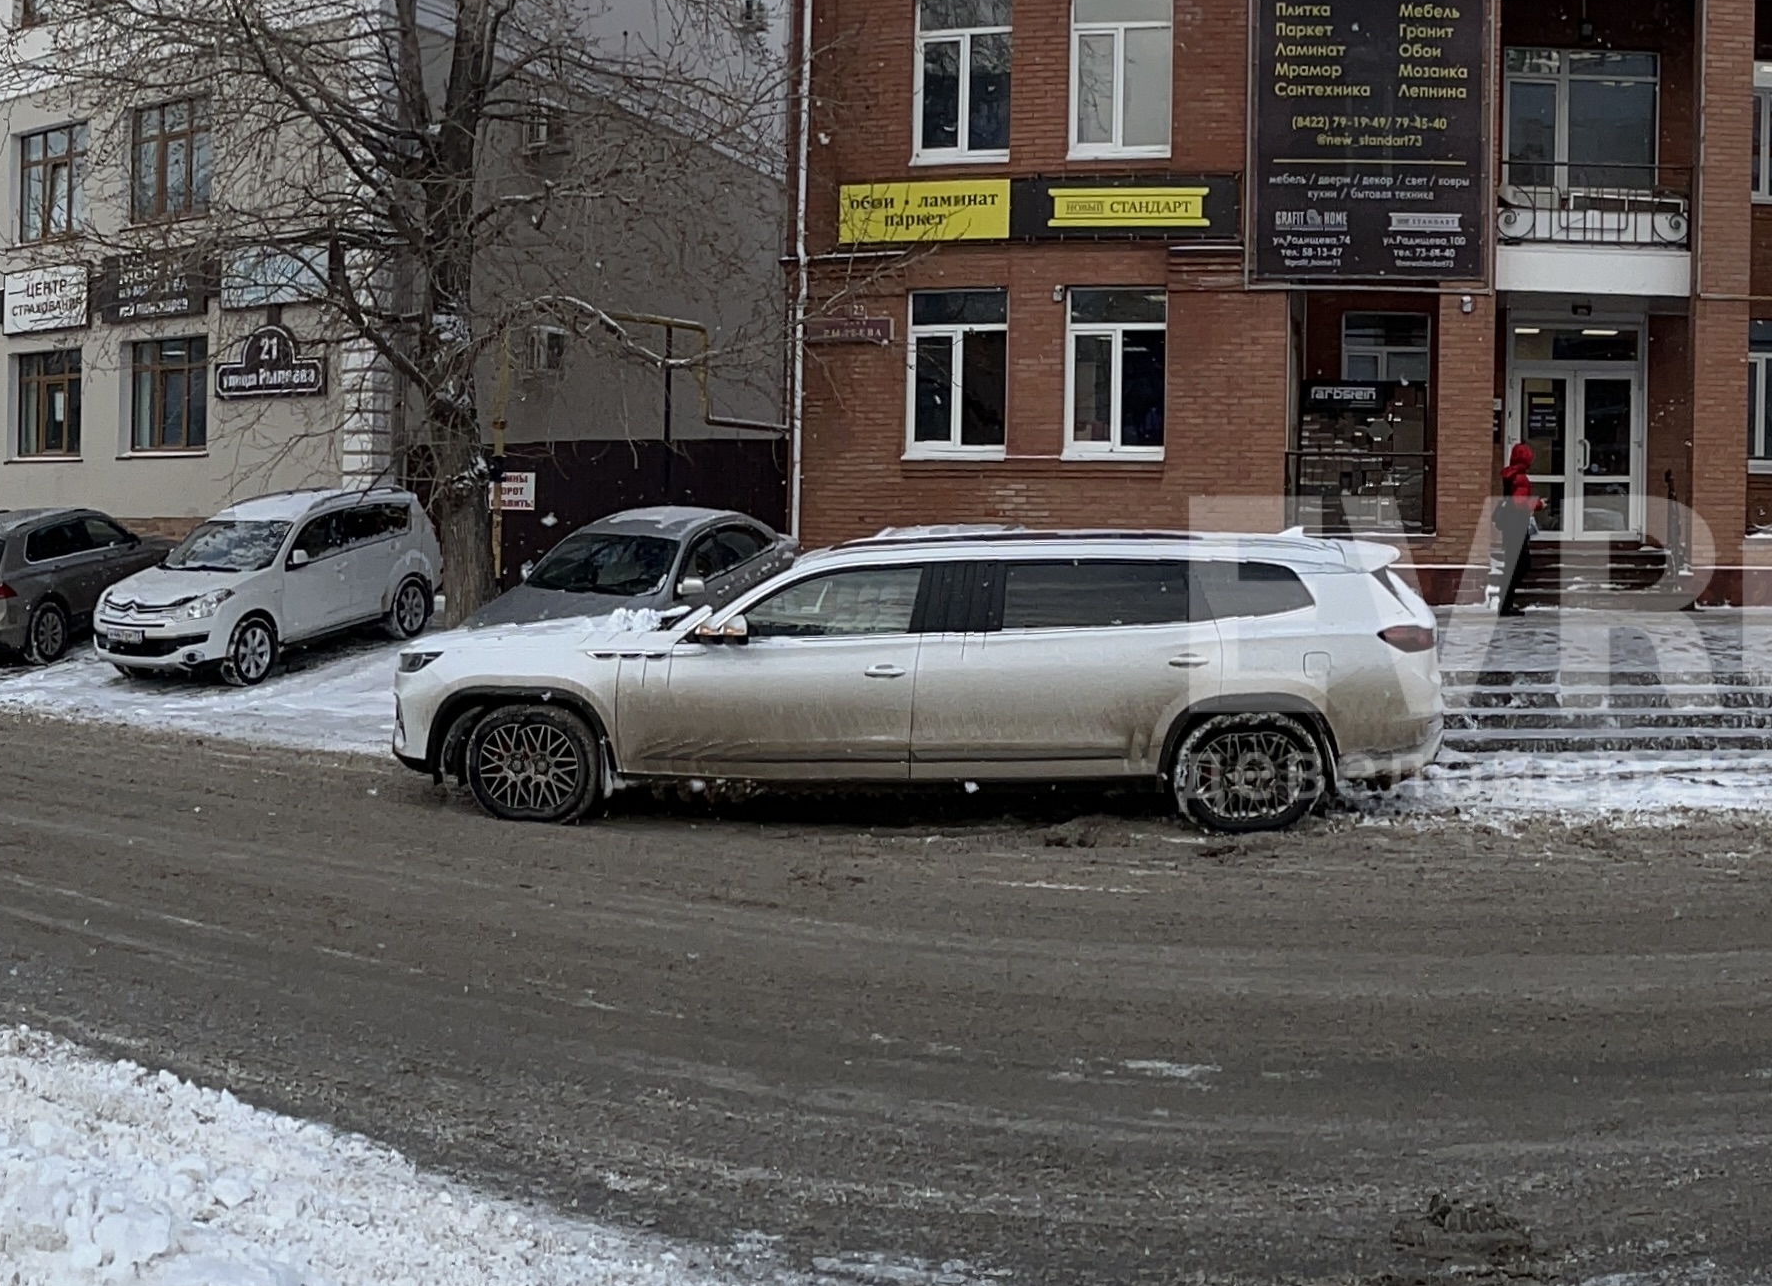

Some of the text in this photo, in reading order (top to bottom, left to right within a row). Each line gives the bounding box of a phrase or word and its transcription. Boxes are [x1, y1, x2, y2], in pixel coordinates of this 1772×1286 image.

[1275, 3, 1331, 17] Плитка
[1399, 4, 1460, 18] Мебель
[1275, 23, 1333, 38] Паркет
[1399, 24, 1454, 39] Гранит
[1275, 44, 1346, 57] Ламинат
[1399, 44, 1441, 58] Обои
[1275, 63, 1342, 79] Мрамор
[1399, 65, 1468, 79] Мозаика
[1275, 83, 1371, 97] Сантехника
[1398, 84, 1467, 99] Лепнина
[1292, 116, 1329, 130] (8422)
[1269, 174, 1306, 185] мебель
[1362, 176, 1393, 188] декор
[1405, 177, 1427, 186] свет
[1438, 177, 1470, 188] ковры
[850, 193, 998, 210] обои ламинат
[1308, 190, 1337, 201] кухни
[1350, 188, 1392, 199] бытовая
[1395, 190, 1434, 200] техника
[1110, 201, 1192, 214] СТАНДАРТ
[884, 213, 946, 230] паркет
[1275, 211, 1348, 225] GRAFIT HOME
[26, 279, 67, 297] ЦЕНТР
[12, 297, 83, 316] СТРАХОВАНИЯ
[260, 336, 278, 360] 21
[1311, 386, 1376, 400] farbstein
